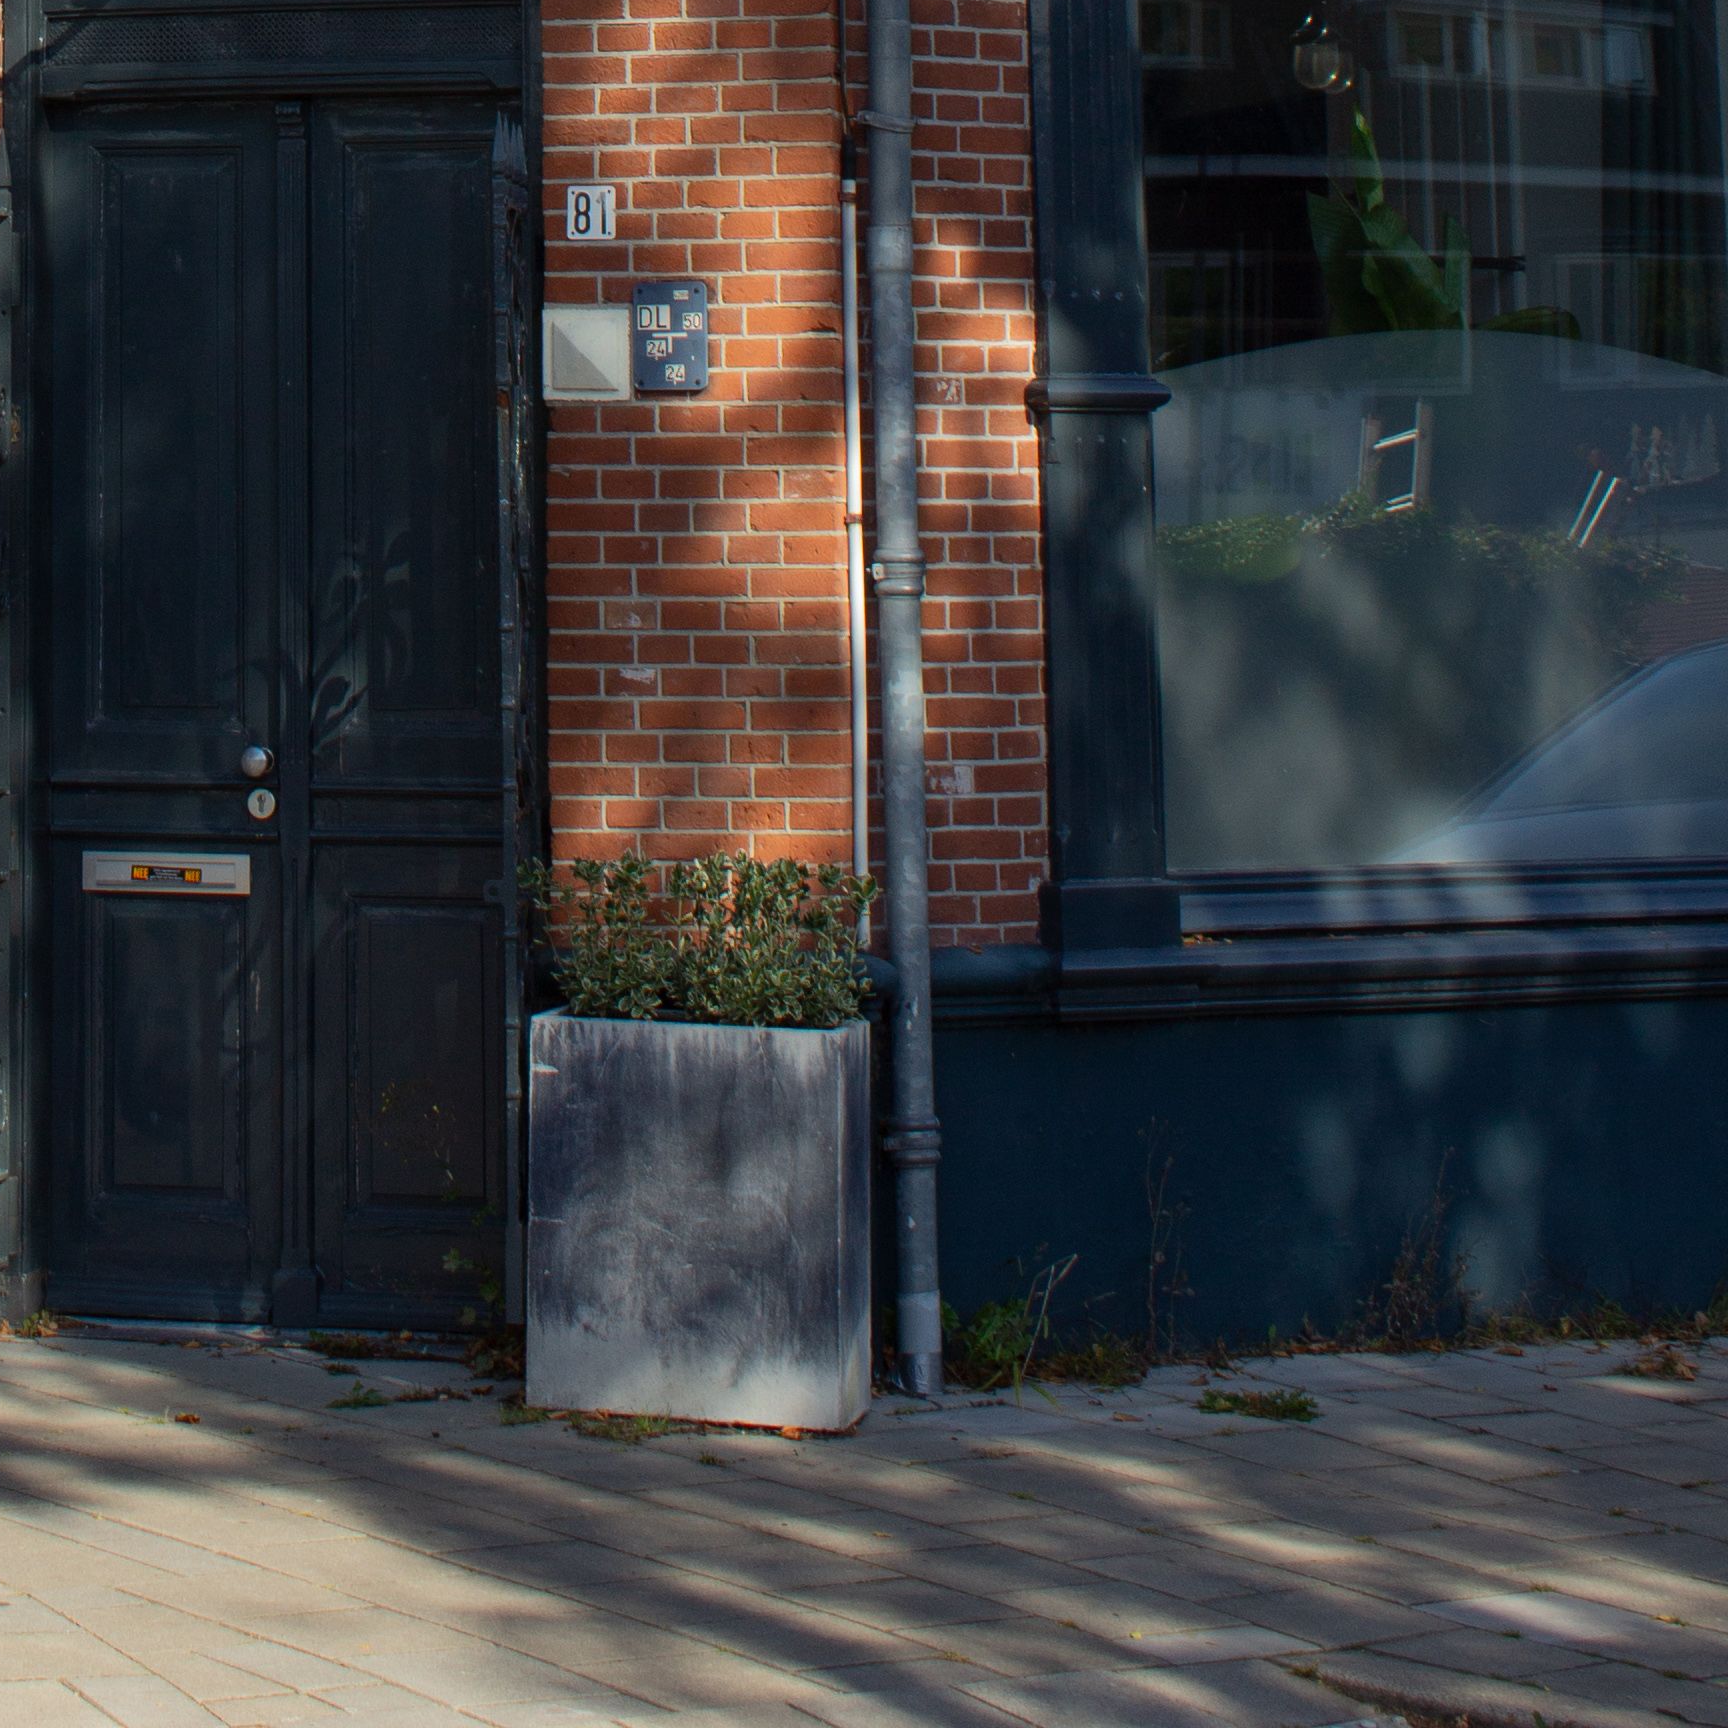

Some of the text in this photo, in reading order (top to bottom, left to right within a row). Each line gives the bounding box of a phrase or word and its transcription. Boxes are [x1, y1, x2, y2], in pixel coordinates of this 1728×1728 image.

[574, 191, 607, 235] 81
[638, 306, 667, 329] DL
[683, 312, 701, 329] 50
